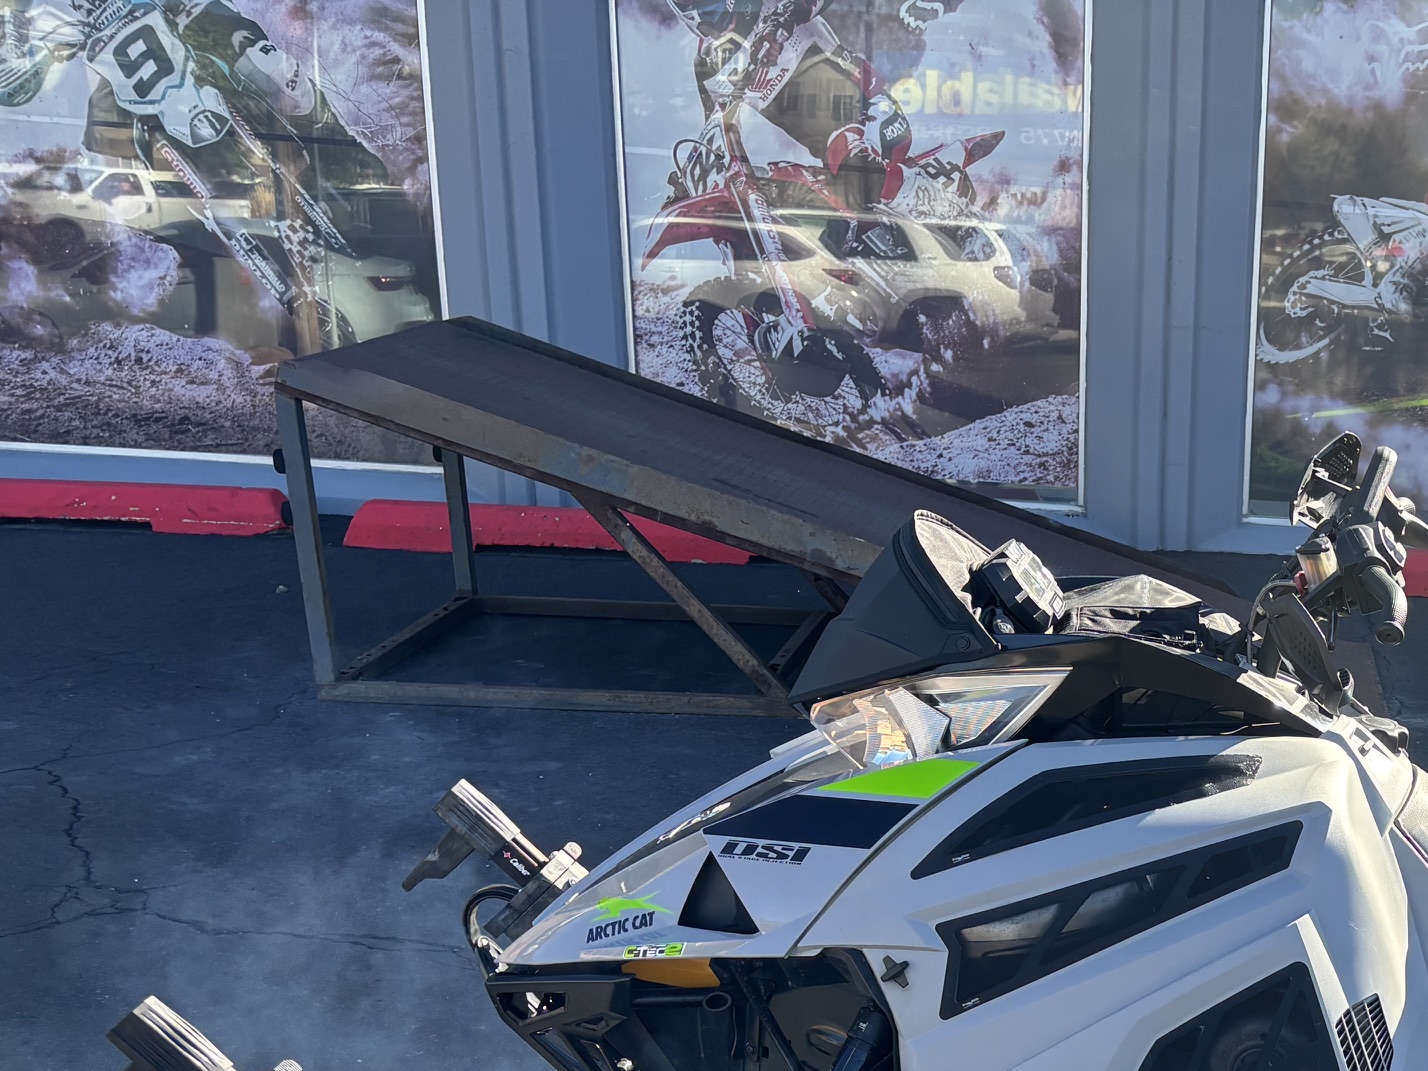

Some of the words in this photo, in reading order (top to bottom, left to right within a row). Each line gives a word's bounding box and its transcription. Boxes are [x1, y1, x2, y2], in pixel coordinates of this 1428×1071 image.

[112, 23, 175, 99] 9
[760, 67, 789, 102] HONDA
[230, 238, 281, 300] DUNLOP
[719, 839, 812, 863] DSI
[585, 917, 630, 944] ARCTIC
[631, 910, 656, 930] CAT
